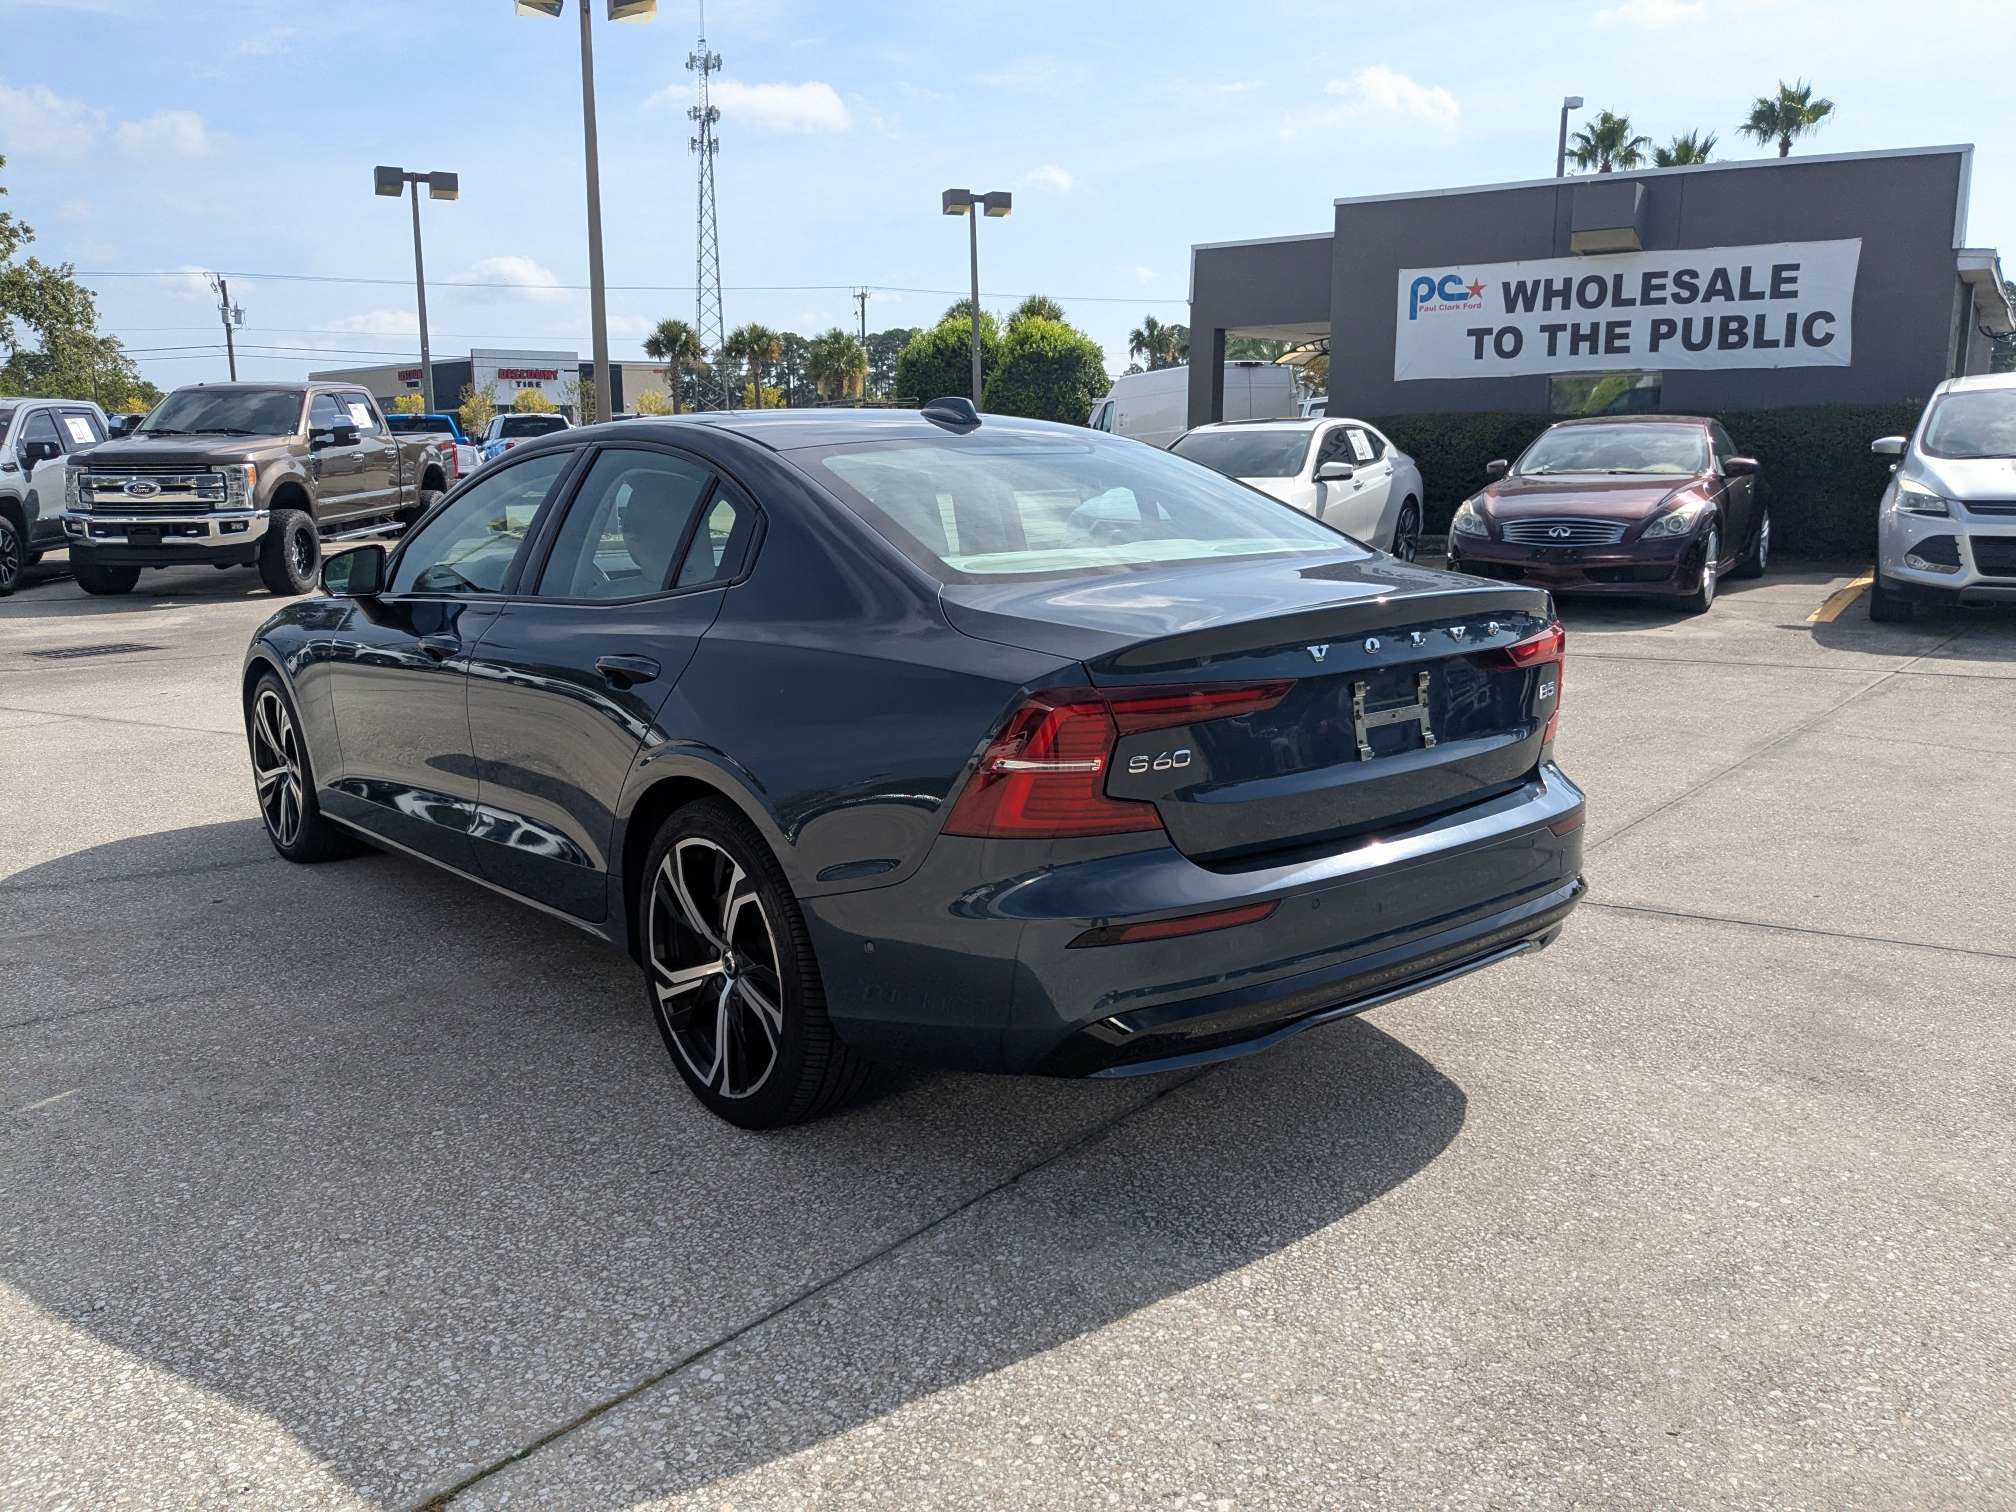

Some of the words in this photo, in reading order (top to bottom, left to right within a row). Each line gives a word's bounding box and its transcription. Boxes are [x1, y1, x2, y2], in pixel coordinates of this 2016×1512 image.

[1418, 304, 1437, 312] Paul
[1439, 303, 1460, 312] Clark
[1463, 302, 1482, 310] Ford
[1502, 263, 1800, 314] WHOLESALE
[1466, 325, 1523, 360] TO
[1540, 320, 1632, 356] THE
[1648, 310, 1836, 353] PUBLIC
[1306, 621, 1500, 662] VOLVO
[1128, 750, 1191, 773] S60
